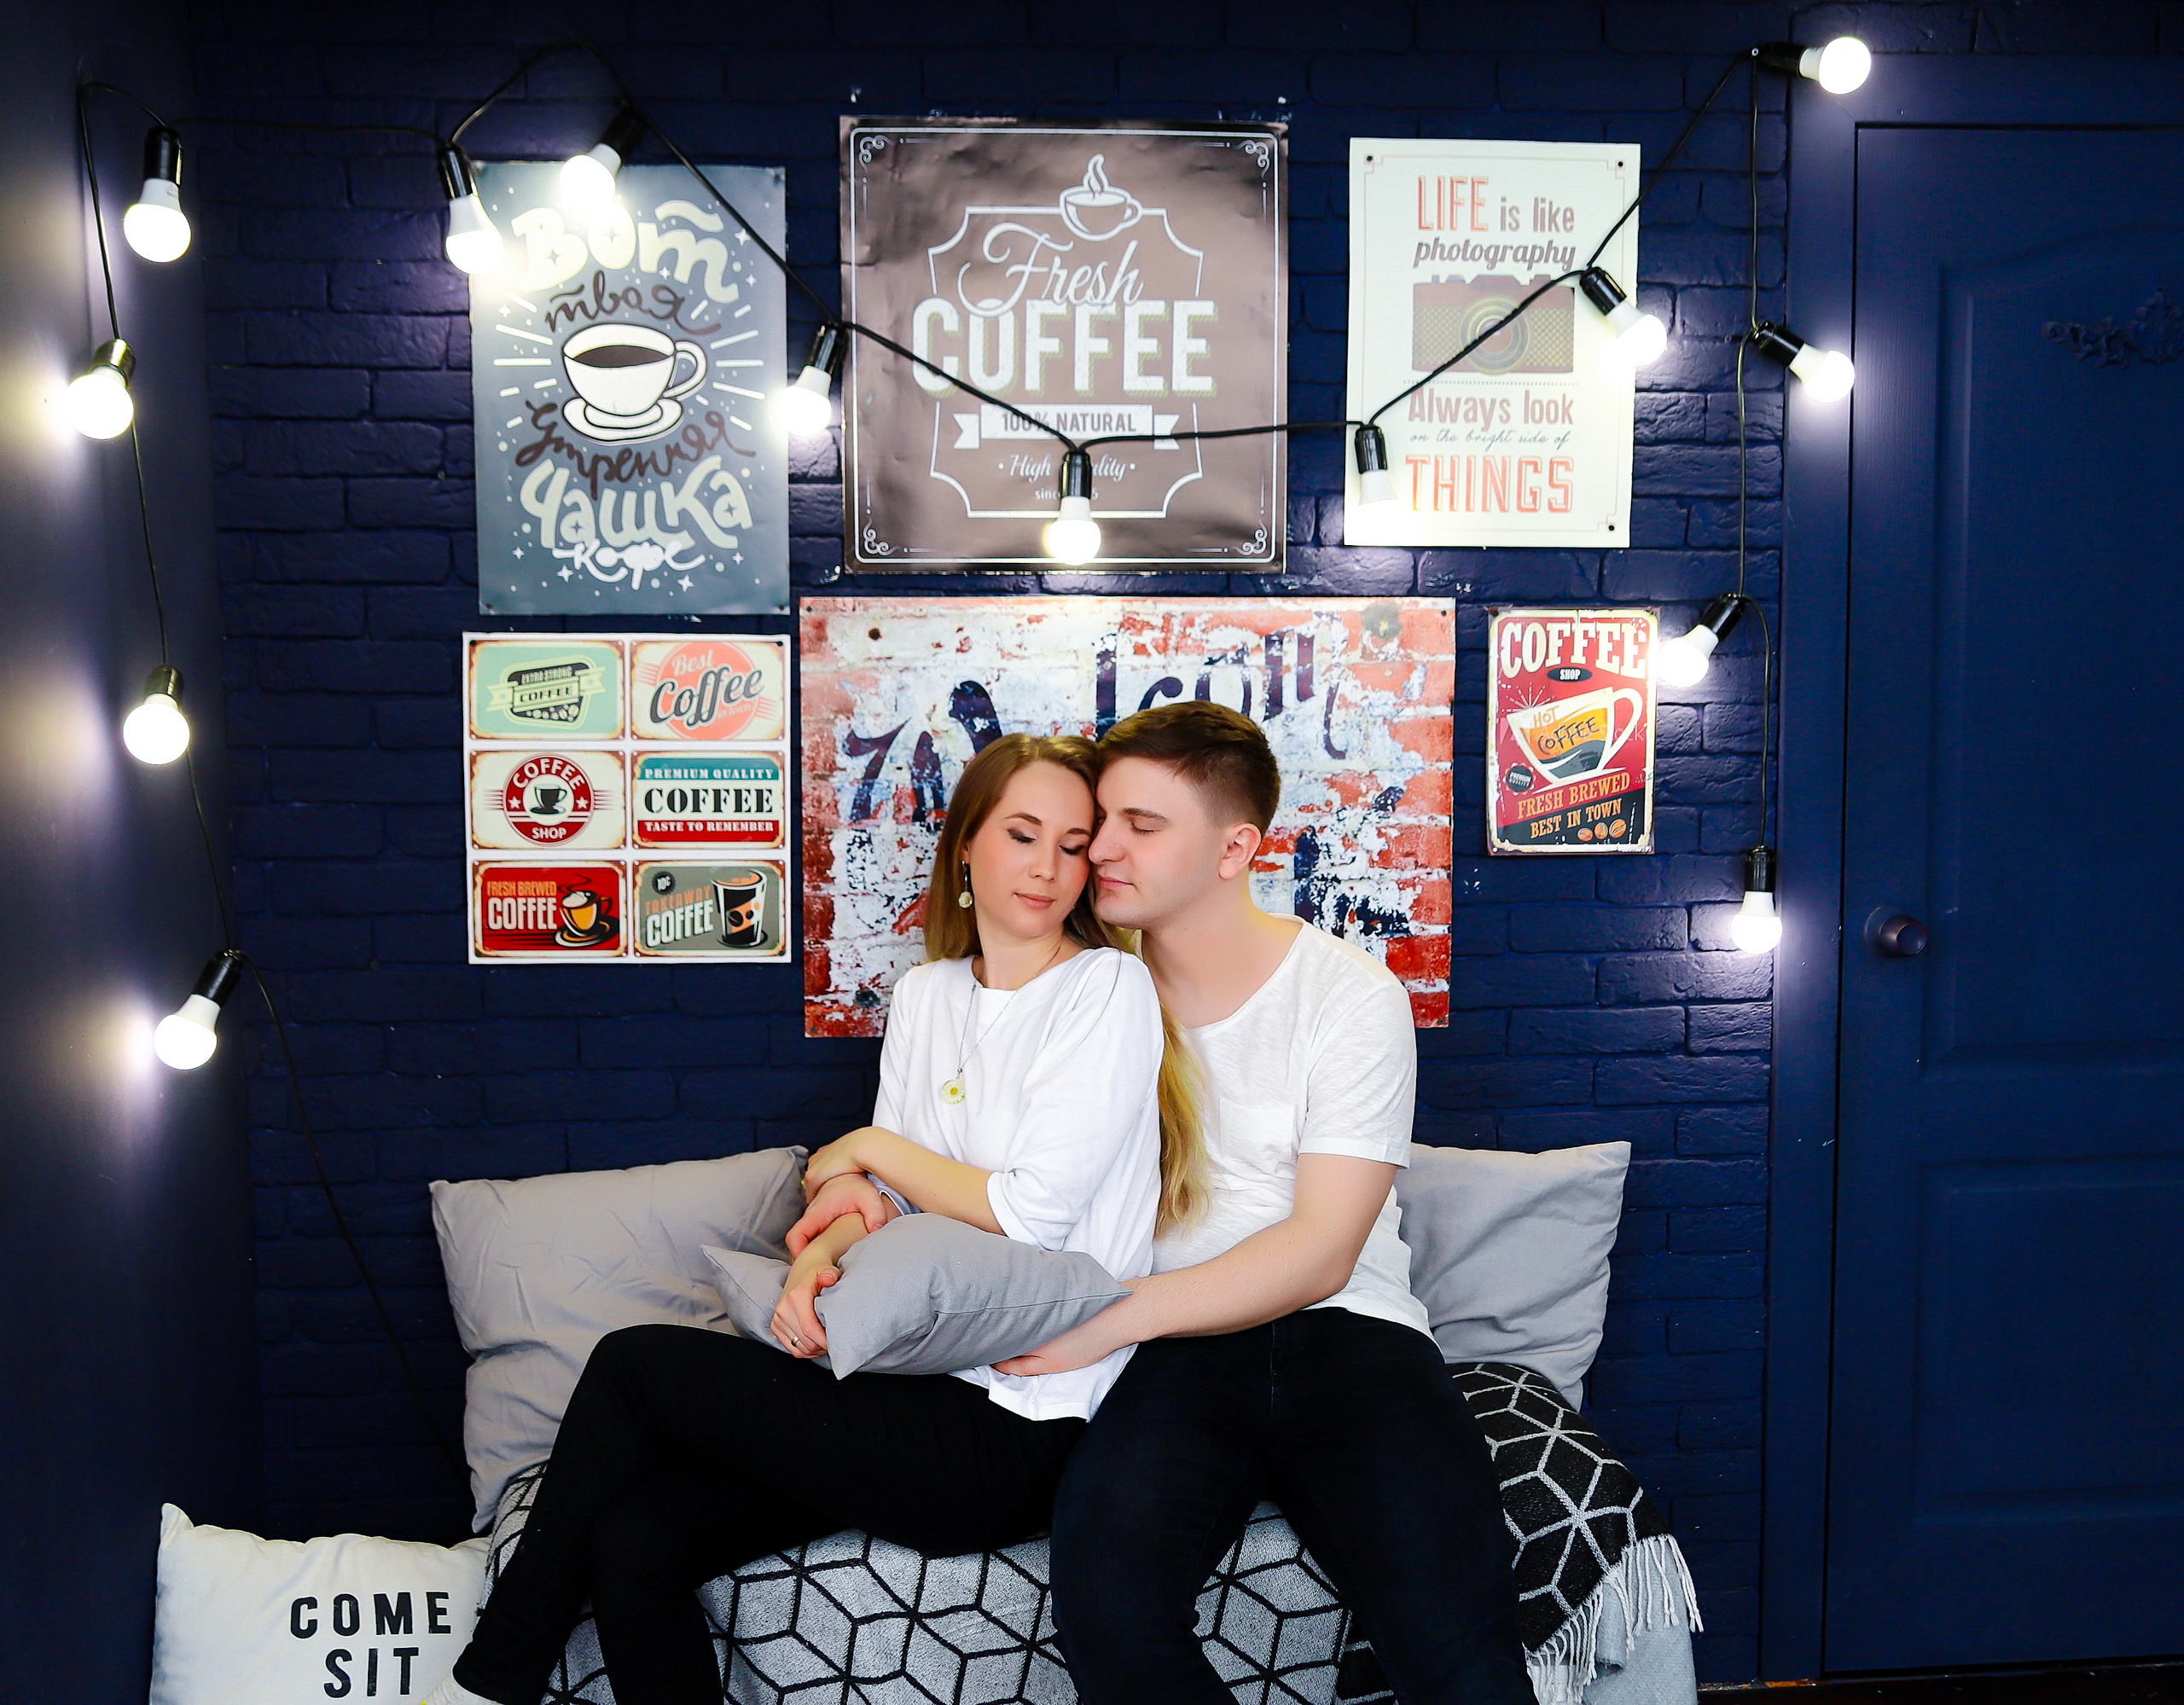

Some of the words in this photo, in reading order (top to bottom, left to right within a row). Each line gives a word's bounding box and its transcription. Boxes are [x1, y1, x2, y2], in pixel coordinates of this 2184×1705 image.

[1418, 175, 1490, 232] LIFE
[1500, 195, 1521, 232] is
[1532, 196, 1576, 233] like
[957, 222, 1145, 318] Fresh
[1413, 236, 1577, 273] photography
[911, 296, 1217, 396] COFFEE
[1055, 412, 1137, 433] NATURAL
[1408, 386, 1512, 433] Always
[1523, 389, 1574, 425] look
[1409, 434, 1430, 443] on
[1436, 428, 1459, 443] the
[1465, 428, 1518, 453] bright
[1518, 432, 1549, 444] side
[1553, 430, 1571, 451] of
[1009, 453, 1052, 484] High
[1405, 453, 1574, 513] THINGS
[1034, 487, 1060, 501] sinc
[671, 649, 715, 677] Best
[1501, 620, 1647, 680] COFFEE
[1559, 669, 1581, 681] SHOP
[520, 685, 573, 703] COFFEE
[649, 666, 765, 727] Coffee
[1533, 705, 1560, 727] HOT
[1538, 716, 1600, 756] COFFEE
[513, 757, 585, 791] COFFEE
[644, 768, 710, 780] PREMIUM
[712, 768, 775, 780] QUALITY
[644, 787, 773, 814] COFFEE
[1518, 789, 1565, 820] FRESH
[1569, 771, 1631, 806] BREWED
[531, 826, 567, 840] SHOP
[644, 821, 684, 832] TASTE
[687, 821, 705, 832] TO
[706, 821, 775, 832] REMEMBER
[1531, 815, 1562, 839] BEST
[1566, 809, 1582, 829] IN
[1586, 798, 1623, 823] TOWN
[486, 880, 517, 897] FRESH
[517, 880, 557, 897] BREWED
[644, 884, 712, 916] TAKEAWAY
[487, 896, 558, 931] COFFEE
[646, 898, 714, 948] COFFEE
[290, 1591, 452, 1639] COME
[323, 1647, 420, 1699] SIT
